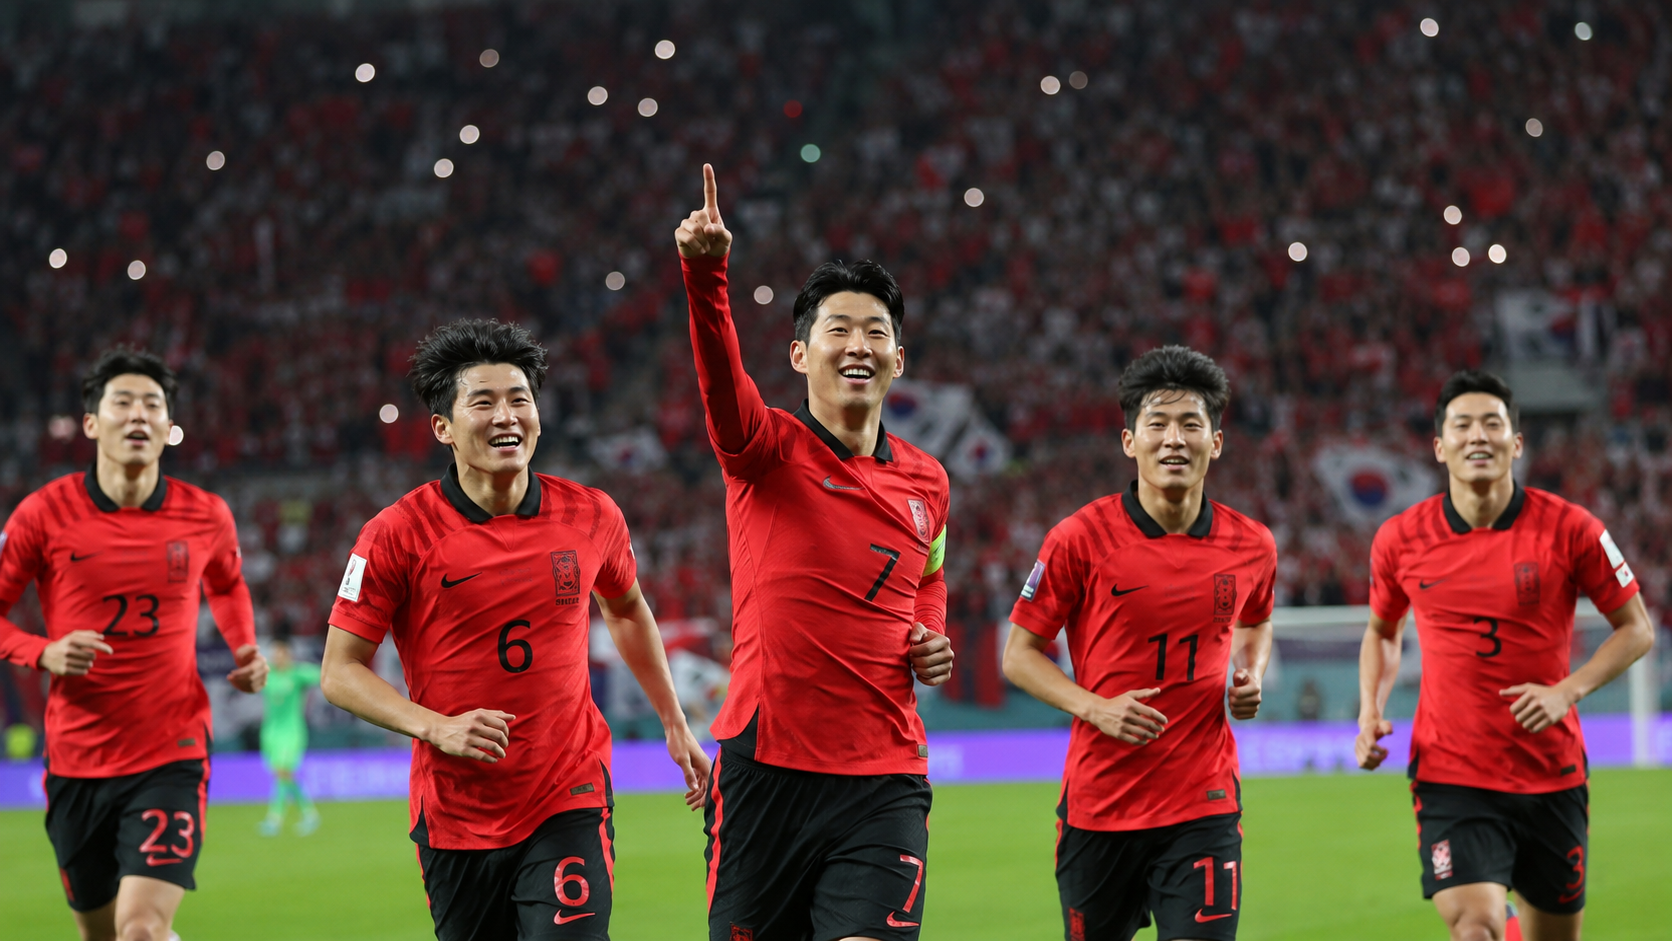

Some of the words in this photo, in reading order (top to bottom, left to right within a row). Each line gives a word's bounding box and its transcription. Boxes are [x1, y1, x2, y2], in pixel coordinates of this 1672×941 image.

[864, 543, 901, 602] 7
[102, 594, 160, 638] 23
[1473, 617, 1502, 658] 3
[498, 619, 533, 673] 6
[1148, 634, 1199, 681] 11
[138, 808, 195, 859] 23
[554, 856, 590, 907] 6
[899, 854, 924, 913] 7
[1193, 856, 1238, 910] 11
[1565, 845, 1586, 890] 3
